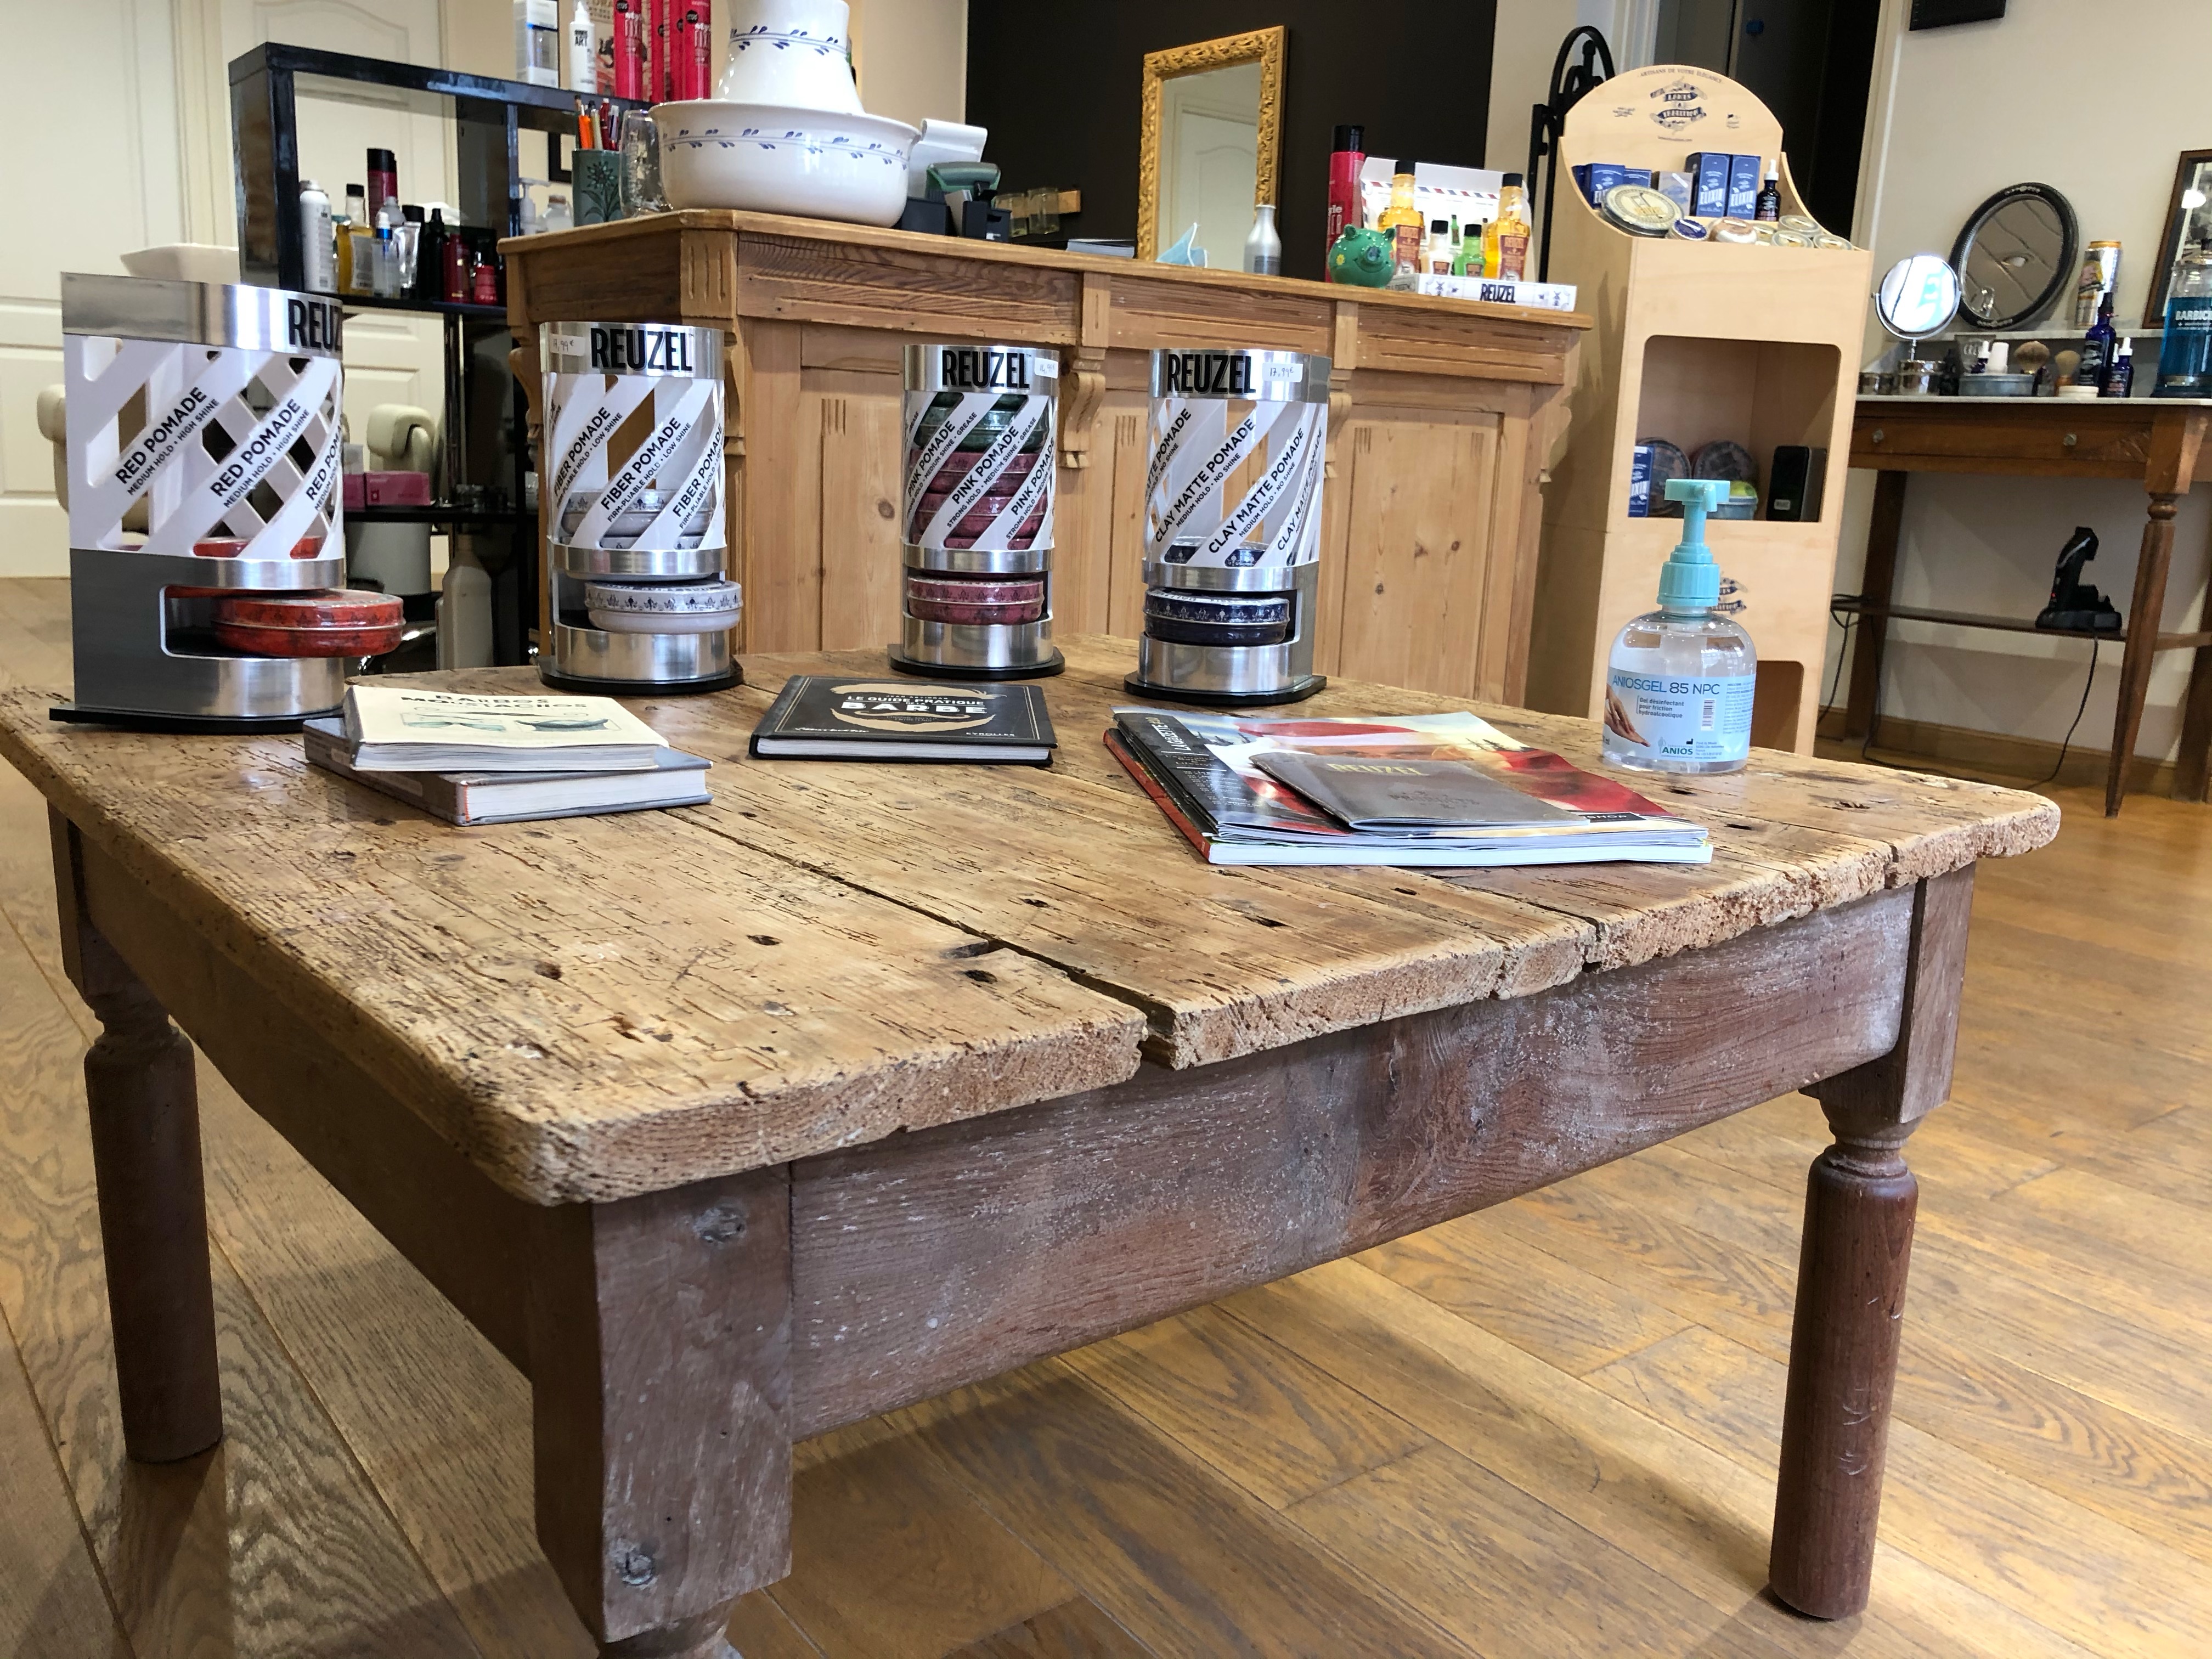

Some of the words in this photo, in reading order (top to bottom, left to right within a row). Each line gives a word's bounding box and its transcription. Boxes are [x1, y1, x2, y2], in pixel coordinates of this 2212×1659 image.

[1480, 284, 1516, 303] REUZEL
[590, 328, 692, 371] REUZEL
[942, 349, 1030, 388] REUZEL
[1167, 354, 1256, 394] REUZEL
[115, 451, 146, 484] RED
[144, 387, 206, 453] POMADE
[127, 465, 156, 495] MEDIUM
[154, 445, 174, 467] HOLD
[177, 421, 197, 441] HIGH
[195, 398, 219, 422] SHINE
[210, 464, 244, 496] RED
[241, 398, 301, 465] POMADE
[223, 478, 253, 508] MEDIUM
[251, 456, 273, 478] HOLD
[276, 432, 294, 452] HIGH
[291, 409, 309, 432] SHINE
[554, 460, 572, 497] FIBER
[568, 407, 611, 462] POMADE
[577, 450, 590, 470] HOLD
[591, 431, 606, 448] LOW
[604, 412, 623, 433] SHINE
[601, 472, 636, 510] FIBER
[631, 417, 681, 474] POMADE
[673, 478, 702, 517] FIBER
[698, 422, 723, 479] POMADE
[907, 469, 922, 498] PINK
[918, 420, 955, 471] POMADE
[924, 456, 941, 479] MEDIUM
[940, 439, 955, 457] SHINE
[956, 412, 978, 436] GREASE
[951, 474, 978, 505] PINK
[975, 426, 1019, 477] POMADE
[1156, 408, 1192, 462] POMADE
[1159, 461, 1167, 474] NO
[1165, 443, 1179, 462] SHINE
[306, 469, 327, 500] RED
[607, 479, 646, 523] FIRM-PLIABLE
[644, 462, 661, 481] HOLD
[663, 441, 677, 459] LOW
[675, 422, 692, 443] SHINE
[679, 484, 708, 529] FIRM-PLIABLE
[947, 504, 967, 528] STRONG
[966, 488, 981, 506] HOLD
[983, 461, 1005, 486] MEDIUM
[1003, 444, 1018, 462] SHINE
[1019, 417, 1037, 441] GREASE
[1011, 486, 1034, 516] PINK
[1030, 436, 1054, 488] POMADE
[1155, 510, 1176, 543] CLAY
[1173, 470, 1209, 513] MATTE
[1206, 418, 1254, 473] POMADE
[1176, 503, 1197, 528] MEDIUM
[1196, 486, 1211, 504] HOLD
[1214, 472, 1224, 483] NO
[1223, 453, 1241, 473] SHINE
[1209, 520, 1238, 554] CLAY
[1236, 479, 1273, 523] MATTE
[1270, 427, 1304, 482] POMADE
[1239, 512, 1261, 538] MEDIUM
[1261, 495, 1274, 514] HOLD
[1276, 481, 1284, 492] NO
[1283, 461, 1296, 482] SHINE
[1006, 516, 1025, 540] STRONG
[1023, 498, 1035, 516] HOLD
[1277, 517, 1296, 551] CLAY
[1295, 477, 1309, 519] MATTE
[840, 702, 988, 714] BARBE
[1612, 675, 1667, 693] ANIOSGEL
[1669, 682, 1689, 695] 85
[1692, 684, 1720, 695] NPC
[1638, 709, 1683, 719] hydroalcoolique
[1649, 698, 1684, 707] désinfectant
[1326, 764, 1431, 776] REUZEL
[1662, 747, 1694, 755] ANIOS
